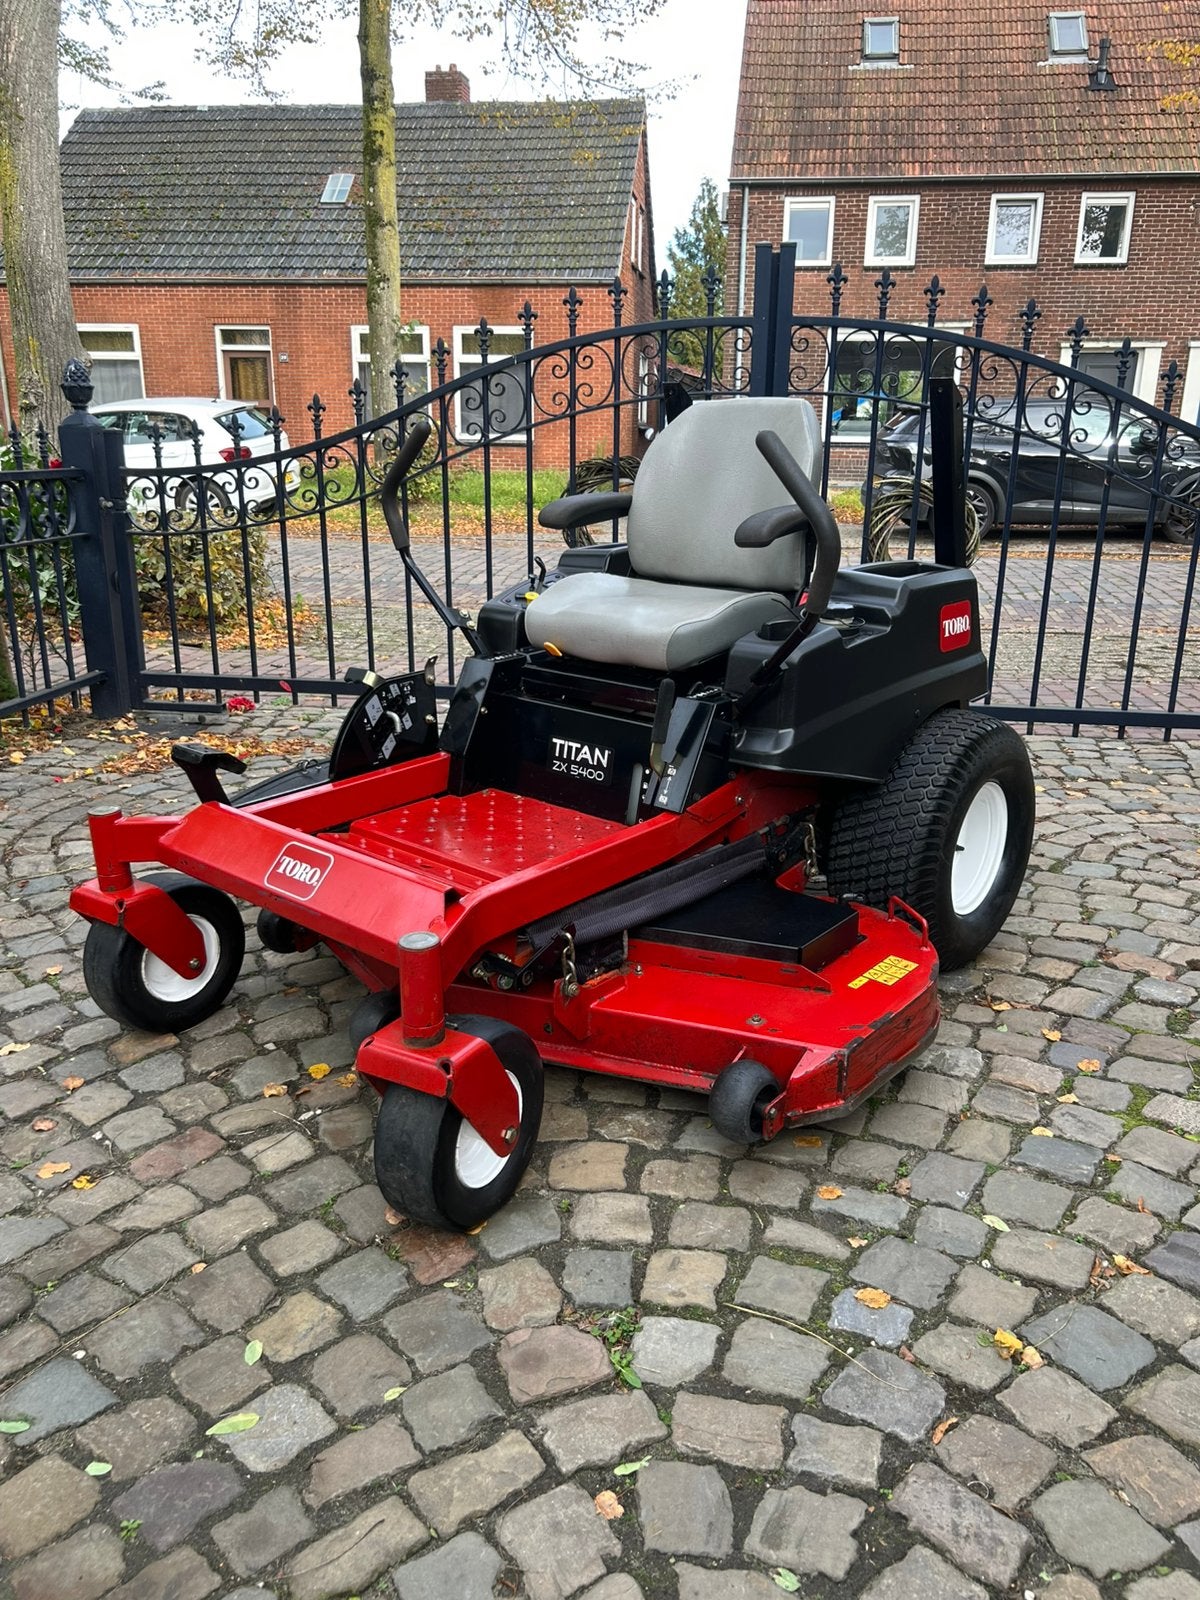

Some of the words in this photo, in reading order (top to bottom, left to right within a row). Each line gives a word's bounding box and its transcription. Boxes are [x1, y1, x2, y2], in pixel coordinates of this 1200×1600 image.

[943, 615, 970, 637] TORO
[552, 737, 609, 768] TITAN
[552, 760, 568, 773] ZX
[570, 764, 605, 781] 5400
[276, 855, 321, 886] TORO
